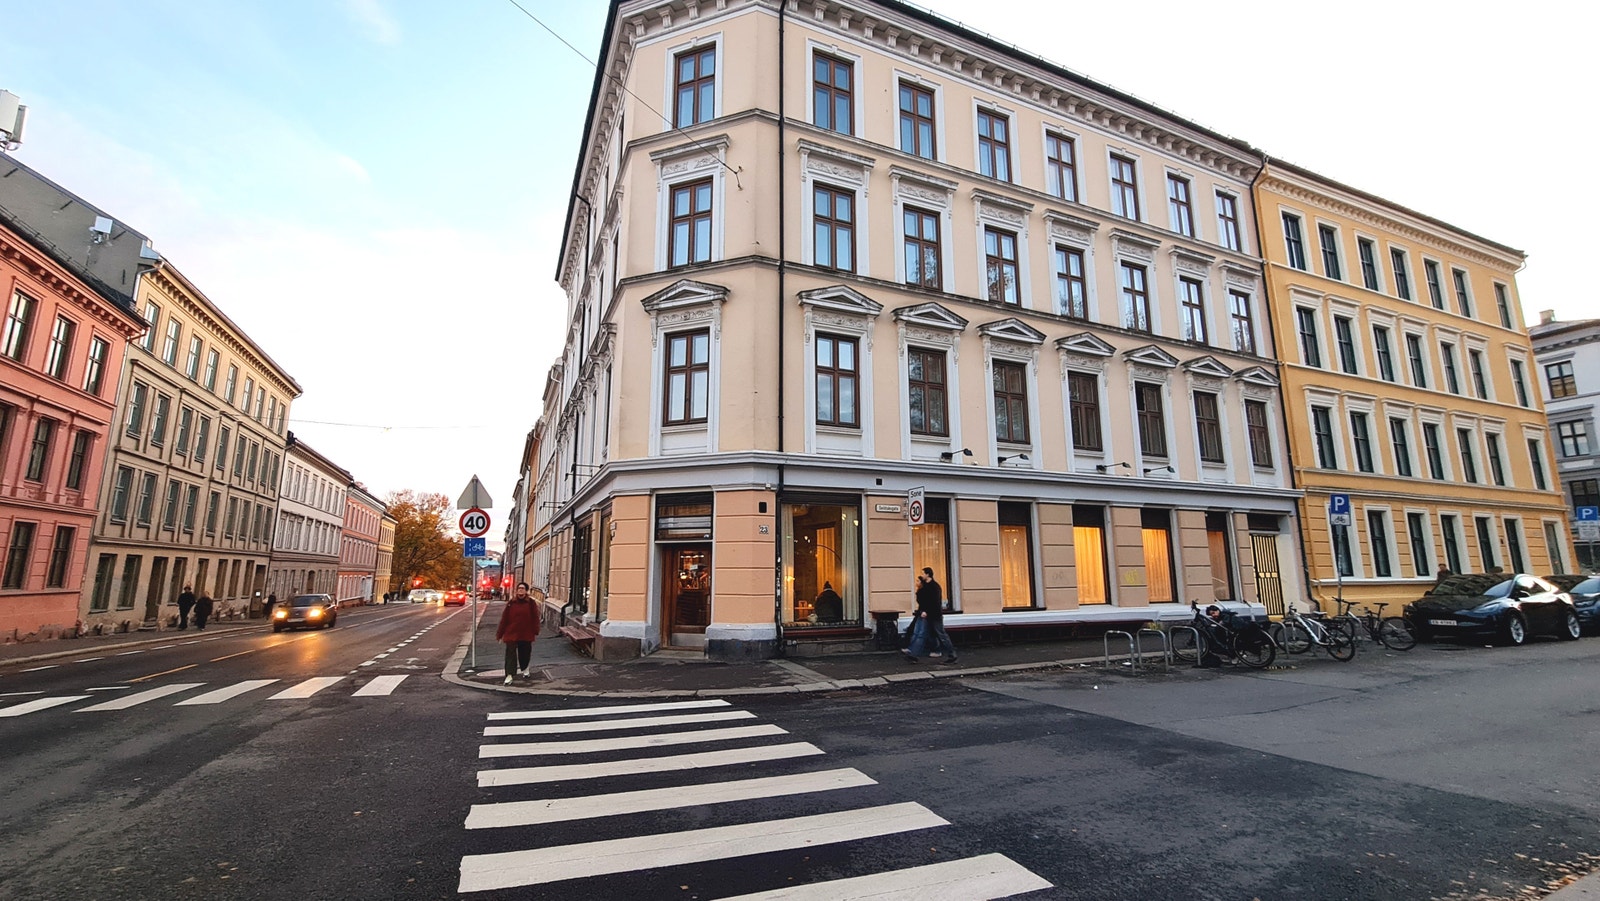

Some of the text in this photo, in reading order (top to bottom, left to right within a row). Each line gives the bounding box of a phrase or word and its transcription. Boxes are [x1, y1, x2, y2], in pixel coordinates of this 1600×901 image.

[1334, 496, 1345, 511] P
[912, 506, 920, 517] 30
[1582, 508, 1593, 519] P
[464, 515, 486, 530] 40
